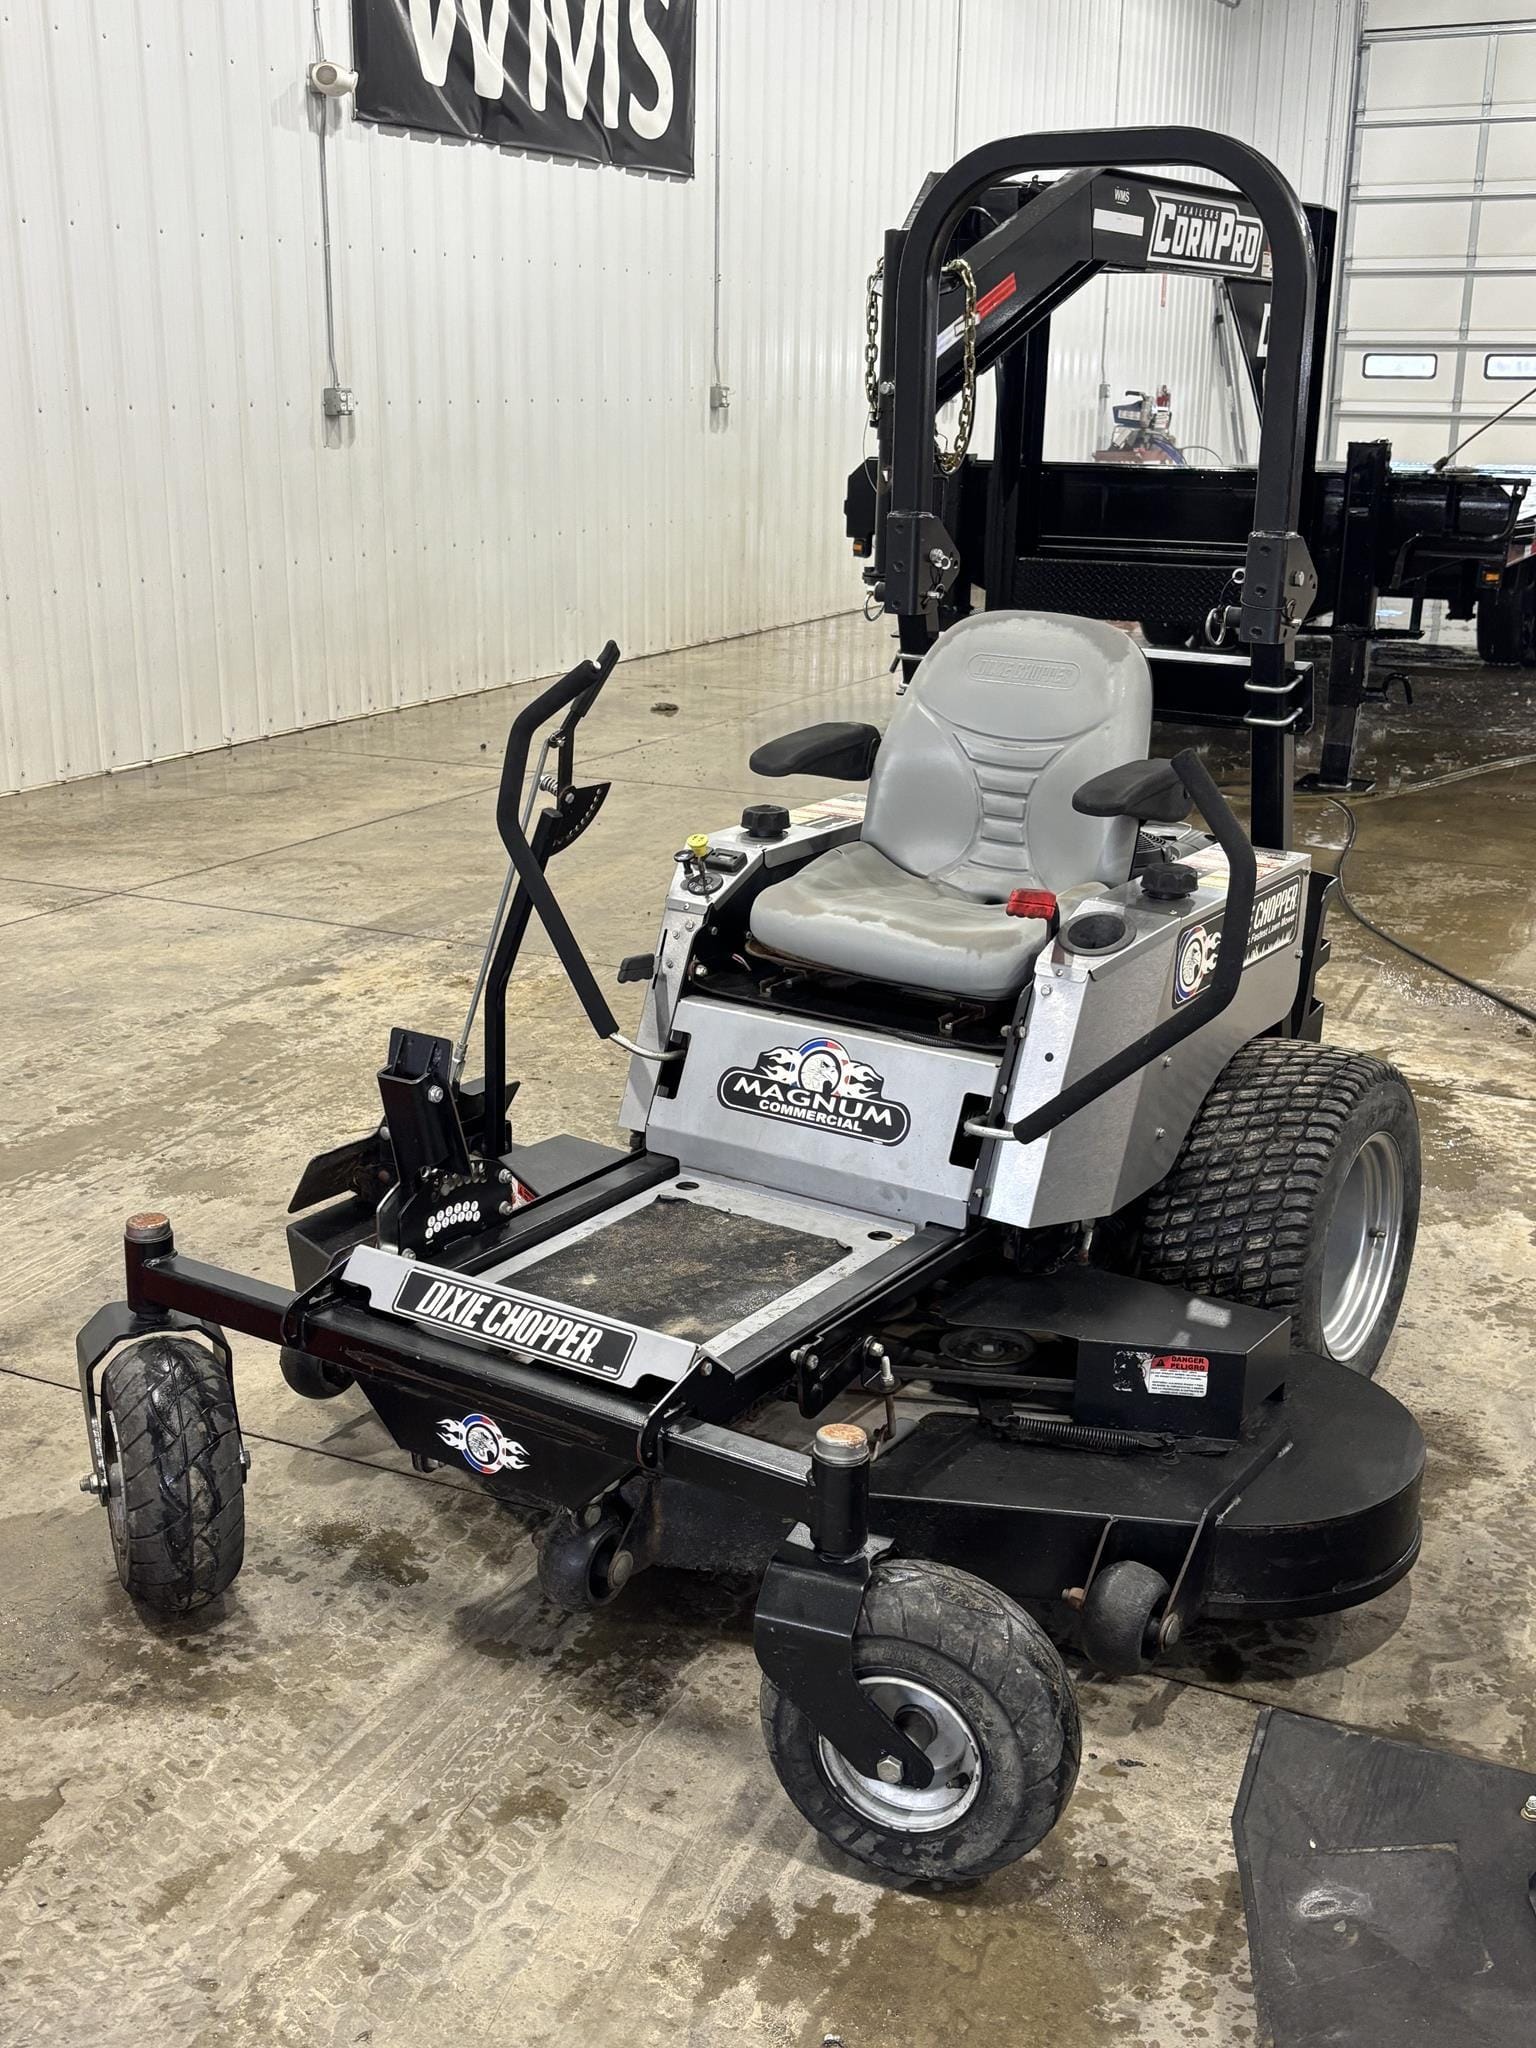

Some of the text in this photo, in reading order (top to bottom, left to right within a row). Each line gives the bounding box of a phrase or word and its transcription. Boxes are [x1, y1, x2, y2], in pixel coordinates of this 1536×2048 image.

[1114, 188, 1130, 203] WMS
[1178, 204, 1221, 220] TRAILERS
[1253, 883, 1298, 930] CHOPPER
[733, 1076, 893, 1126] MAGNUM
[758, 1099, 863, 1132] COMMERCIAL
[415, 1281, 603, 1364] DIXIE CHOPPER
[1170, 1363, 1206, 1371] PELIGRO
[1171, 1355, 1205, 1364] DANGER
